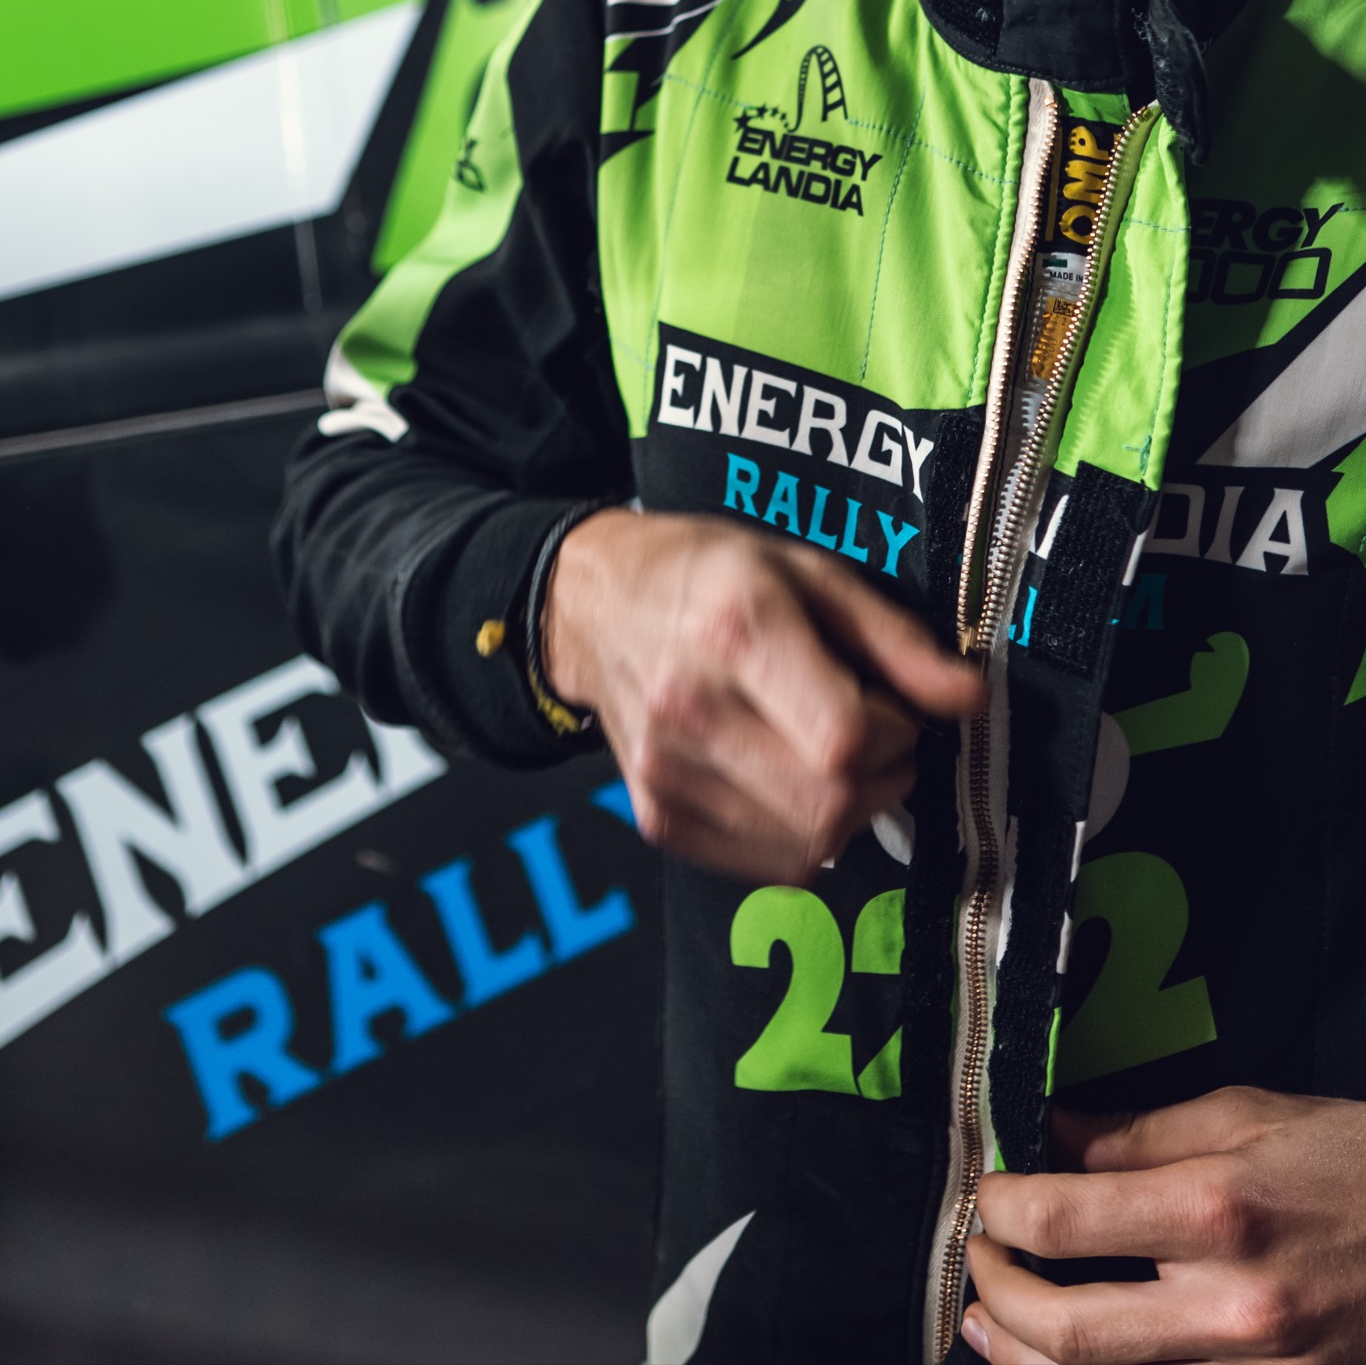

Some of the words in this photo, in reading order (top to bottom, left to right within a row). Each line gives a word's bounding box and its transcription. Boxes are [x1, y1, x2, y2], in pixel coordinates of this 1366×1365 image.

[736, 125, 884, 183] ENERGY
[1059, 124, 1111, 246] OMP
[725, 155, 865, 217] LANDIA
[1189, 197, 1345, 252] ERGY
[1049, 271, 1074, 281] MADE
[1075, 274, 1084, 283] IN
[656, 343, 935, 505] ENERGY
[722, 451, 921, 579] RALLY
